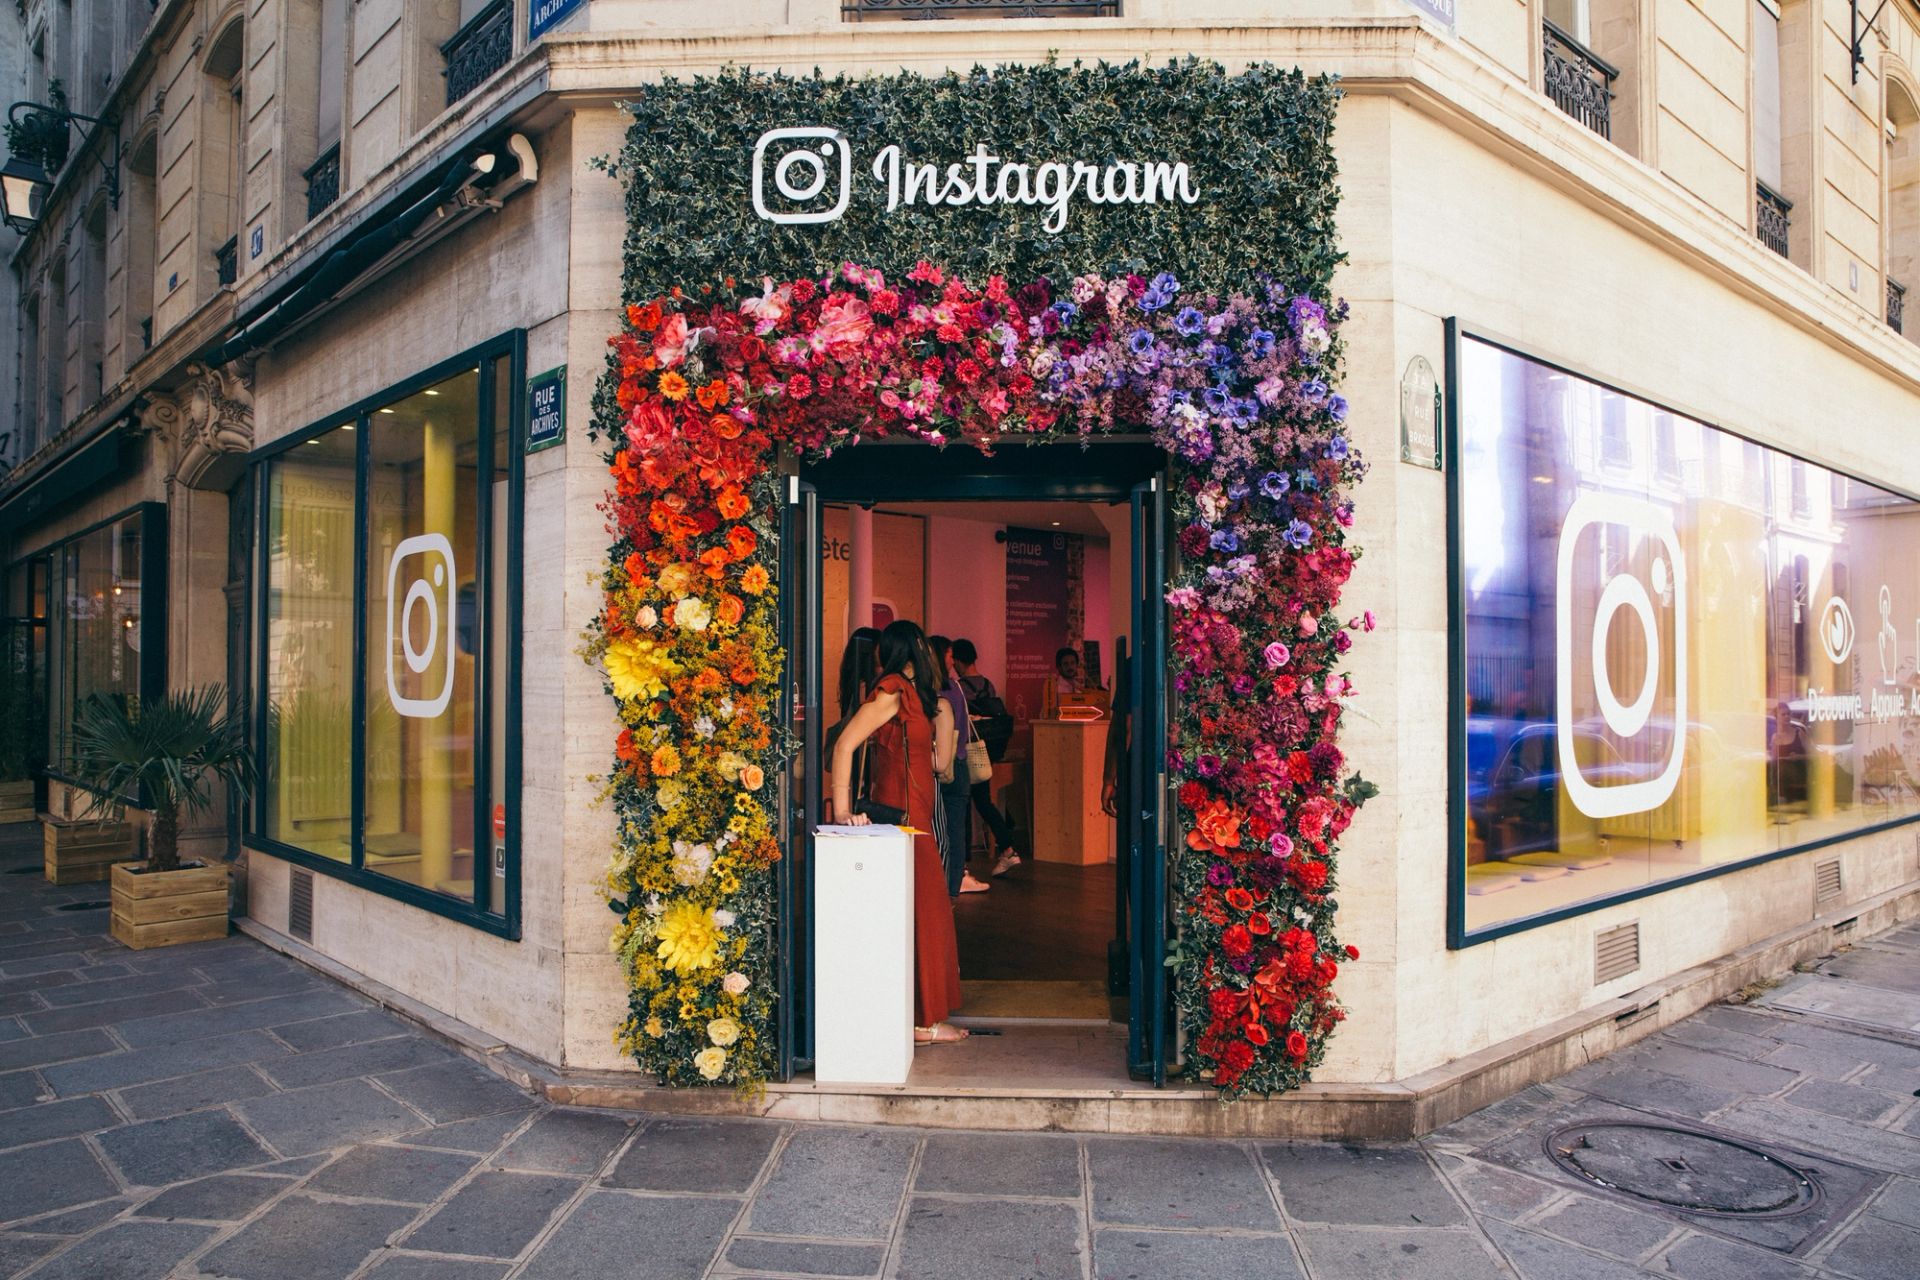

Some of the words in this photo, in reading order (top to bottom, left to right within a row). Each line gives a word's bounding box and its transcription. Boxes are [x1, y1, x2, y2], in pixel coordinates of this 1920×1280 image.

[533, 0, 567, 30] ARCHI
[872, 143, 1200, 234] Instagram
[535, 385, 556, 408] RUE
[539, 405, 551, 416] DES
[1414, 405, 1430, 421] RUE
[531, 411, 559, 436] ARCHIVES
[1808, 686, 1864, 722] Découvre.
[1871, 687, 1907, 725] Appuie.
